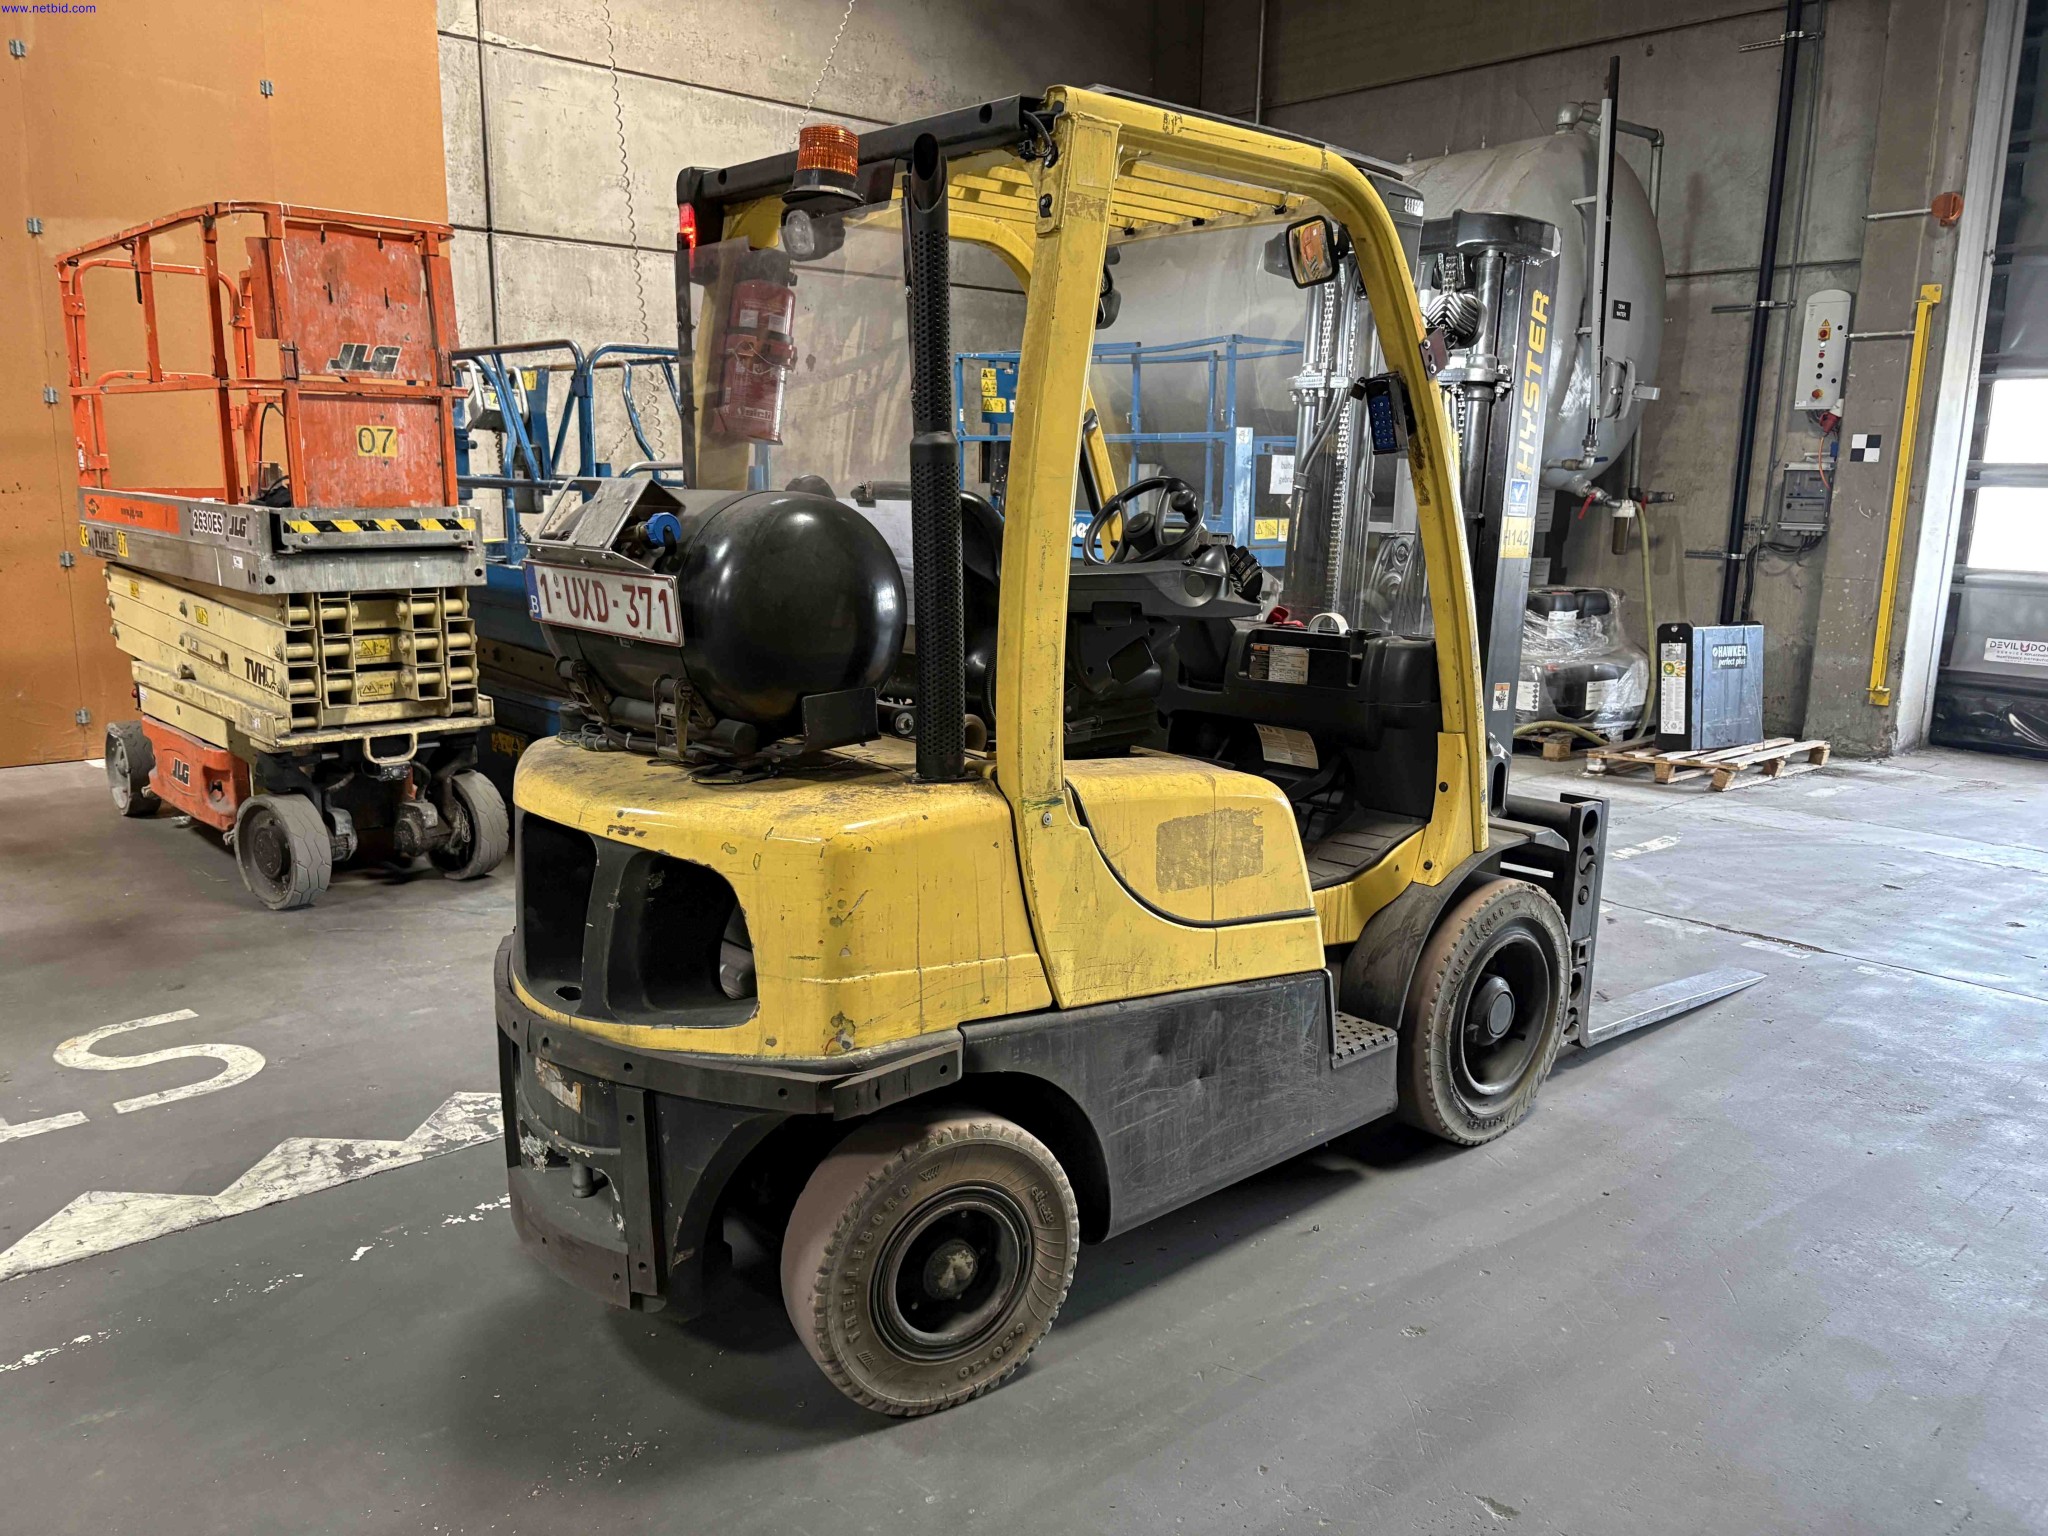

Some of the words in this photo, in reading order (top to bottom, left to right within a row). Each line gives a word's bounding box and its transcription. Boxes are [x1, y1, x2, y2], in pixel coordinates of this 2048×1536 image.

[326, 343, 402, 373] JLG
[1516, 288, 1550, 476] HYSTER
[357, 427, 395, 454] 07
[193, 509, 224, 535] 2630ES
[229, 515, 248, 539] JLG
[93, 529, 110, 550] TVH
[1503, 529, 1530, 547] H142
[530, 595, 540, 613] B
[540, 573, 672, 633] 1-UXD-371
[1718, 645, 1747, 658] HAWKER
[2030, 643, 2048, 652] DO
[244, 657, 268, 686] TVH
[1717, 657, 1735, 668] perfect
[1735, 657, 1746, 667] plus
[172, 757, 191, 787] JLG
[842, 1184, 912, 1344] TRELLEBORG
